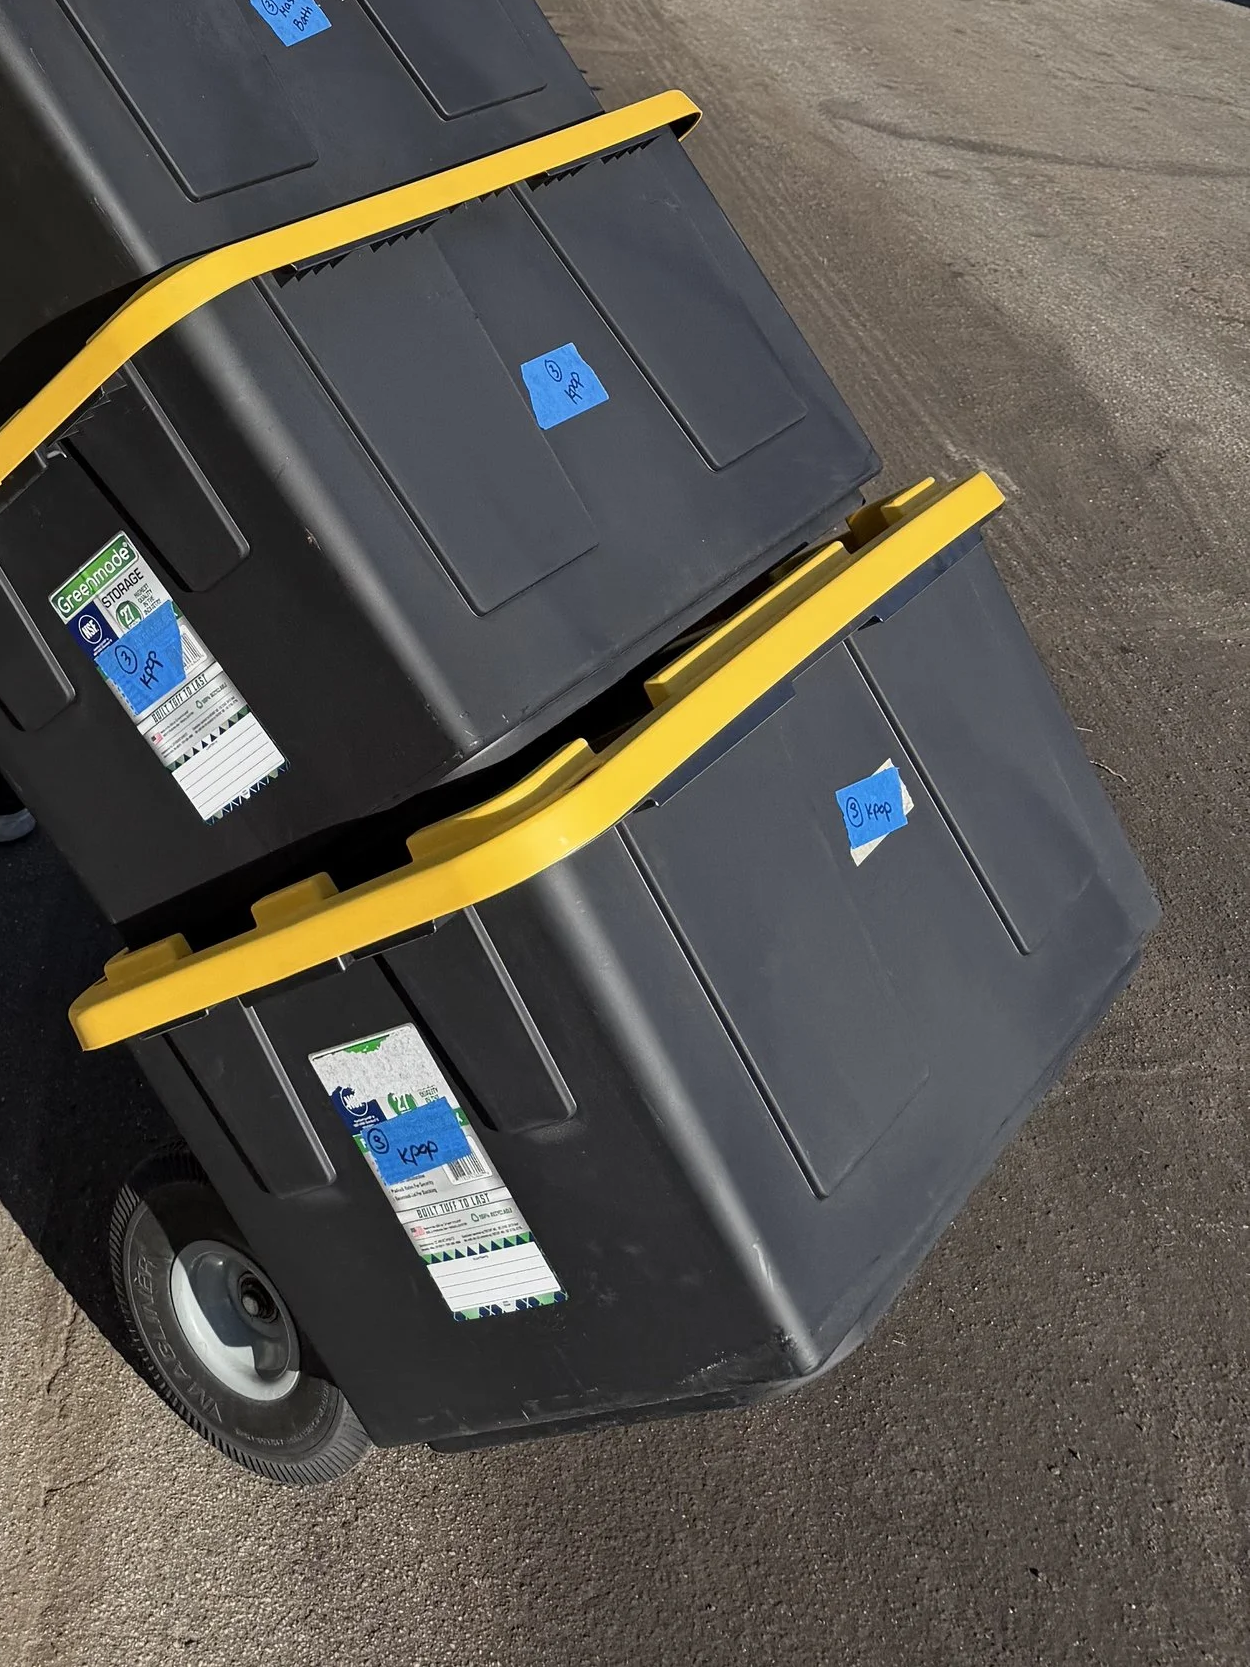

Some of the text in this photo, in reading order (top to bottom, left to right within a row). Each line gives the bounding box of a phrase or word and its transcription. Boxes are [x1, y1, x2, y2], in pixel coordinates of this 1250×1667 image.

[293, 6, 313, 32] Bath
[101, 567, 144, 609] STORAGE
[119, 604, 135, 625] 27
[192, 674, 208, 691] LAST
[416, 1193, 491, 1219] BUILT TUFF TO LAST
